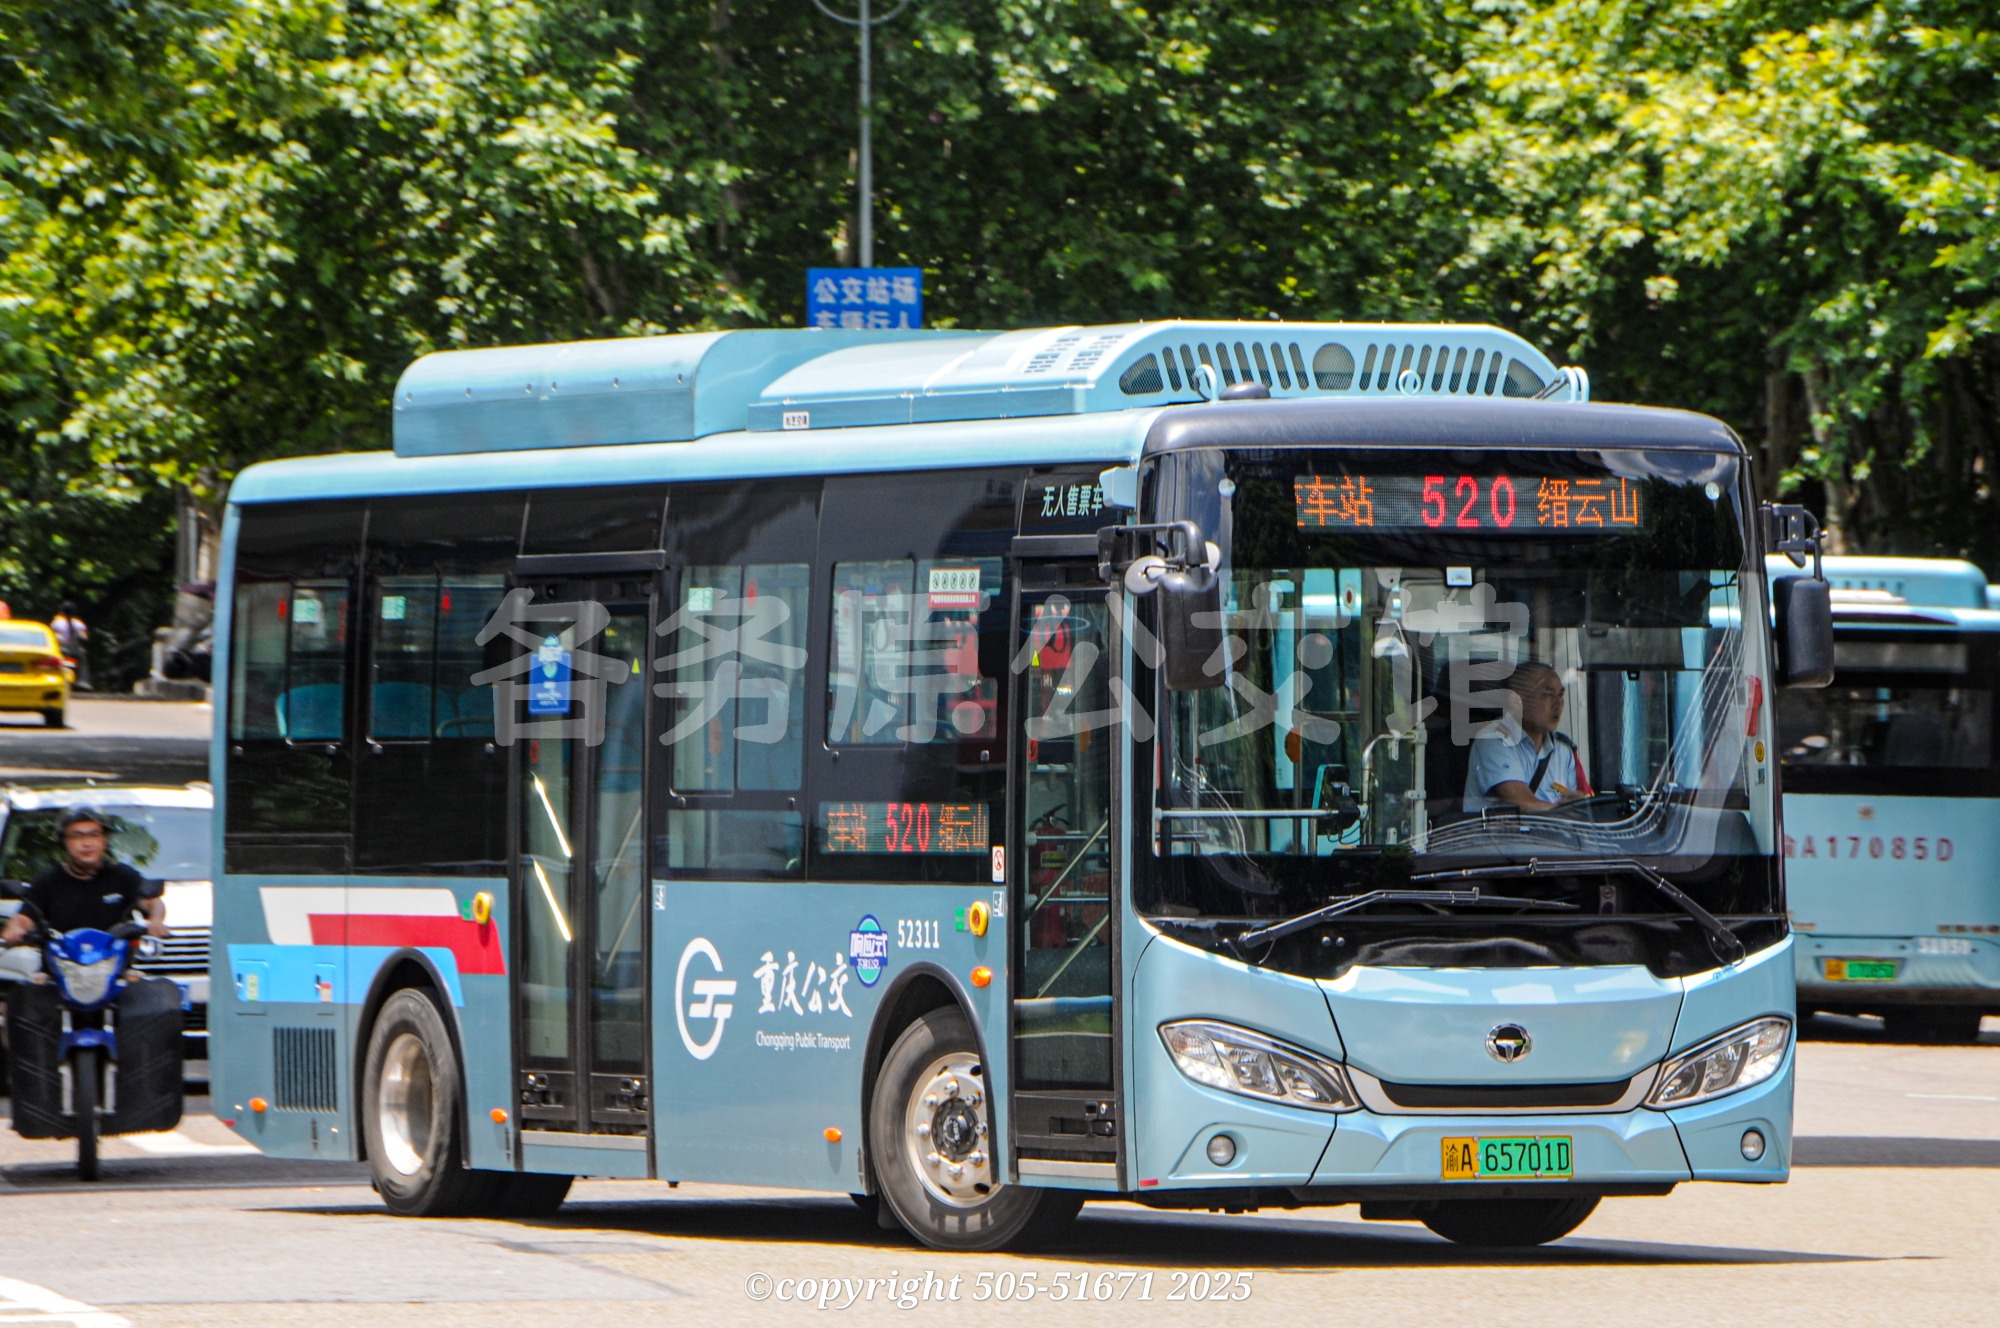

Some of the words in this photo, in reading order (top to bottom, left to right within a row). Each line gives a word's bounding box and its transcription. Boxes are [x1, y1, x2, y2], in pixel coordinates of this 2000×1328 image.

[1040, 482, 1104, 518] 无人售票车
[1422, 475, 1516, 528] 520
[1537, 476, 1638, 528] 缙云山
[885, 802, 931, 852] 520
[938, 803, 988, 852] 缙云山
[897, 918, 940, 949] 52311
[753, 950, 853, 1018] 重庆公交
[755, 1030, 795, 1052] Chongqing
[795, 1032, 816, 1049] Public
[816, 1032, 851, 1053] Transport
